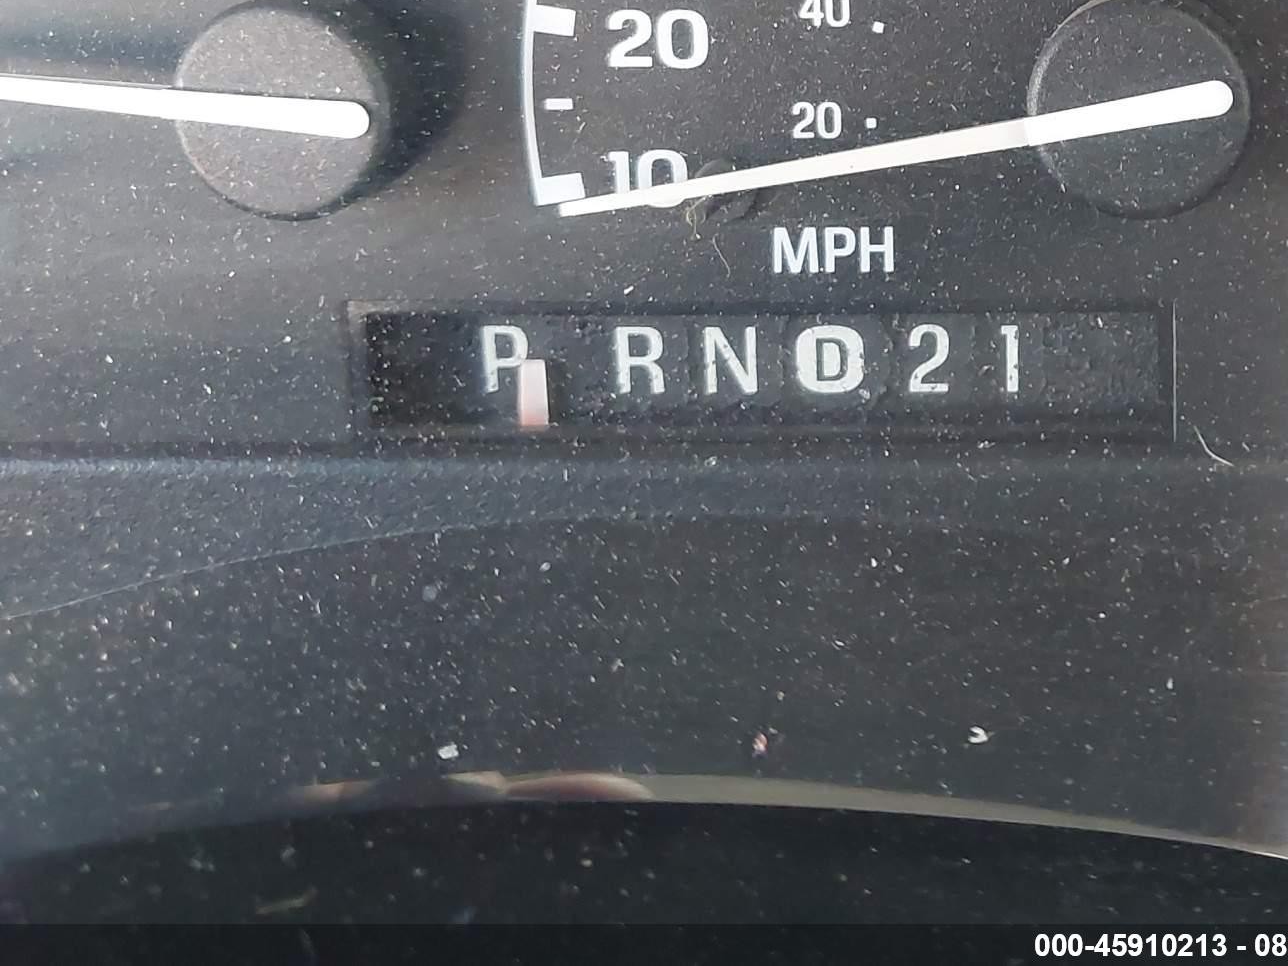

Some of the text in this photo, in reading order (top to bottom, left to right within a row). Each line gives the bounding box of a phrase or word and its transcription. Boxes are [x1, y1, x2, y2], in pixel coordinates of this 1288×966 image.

[607, 9, 708, 69] 20
[792, 101, 842, 139] 20
[607, 149, 688, 208] 10
[774, 227, 895, 274] MPH
[483, 325, 528, 393] P
[616, 326, 665, 394] R
[704, 326, 758, 395] N
[909, 325, 949, 393] 2
[1000, 326, 1019, 392] 1
